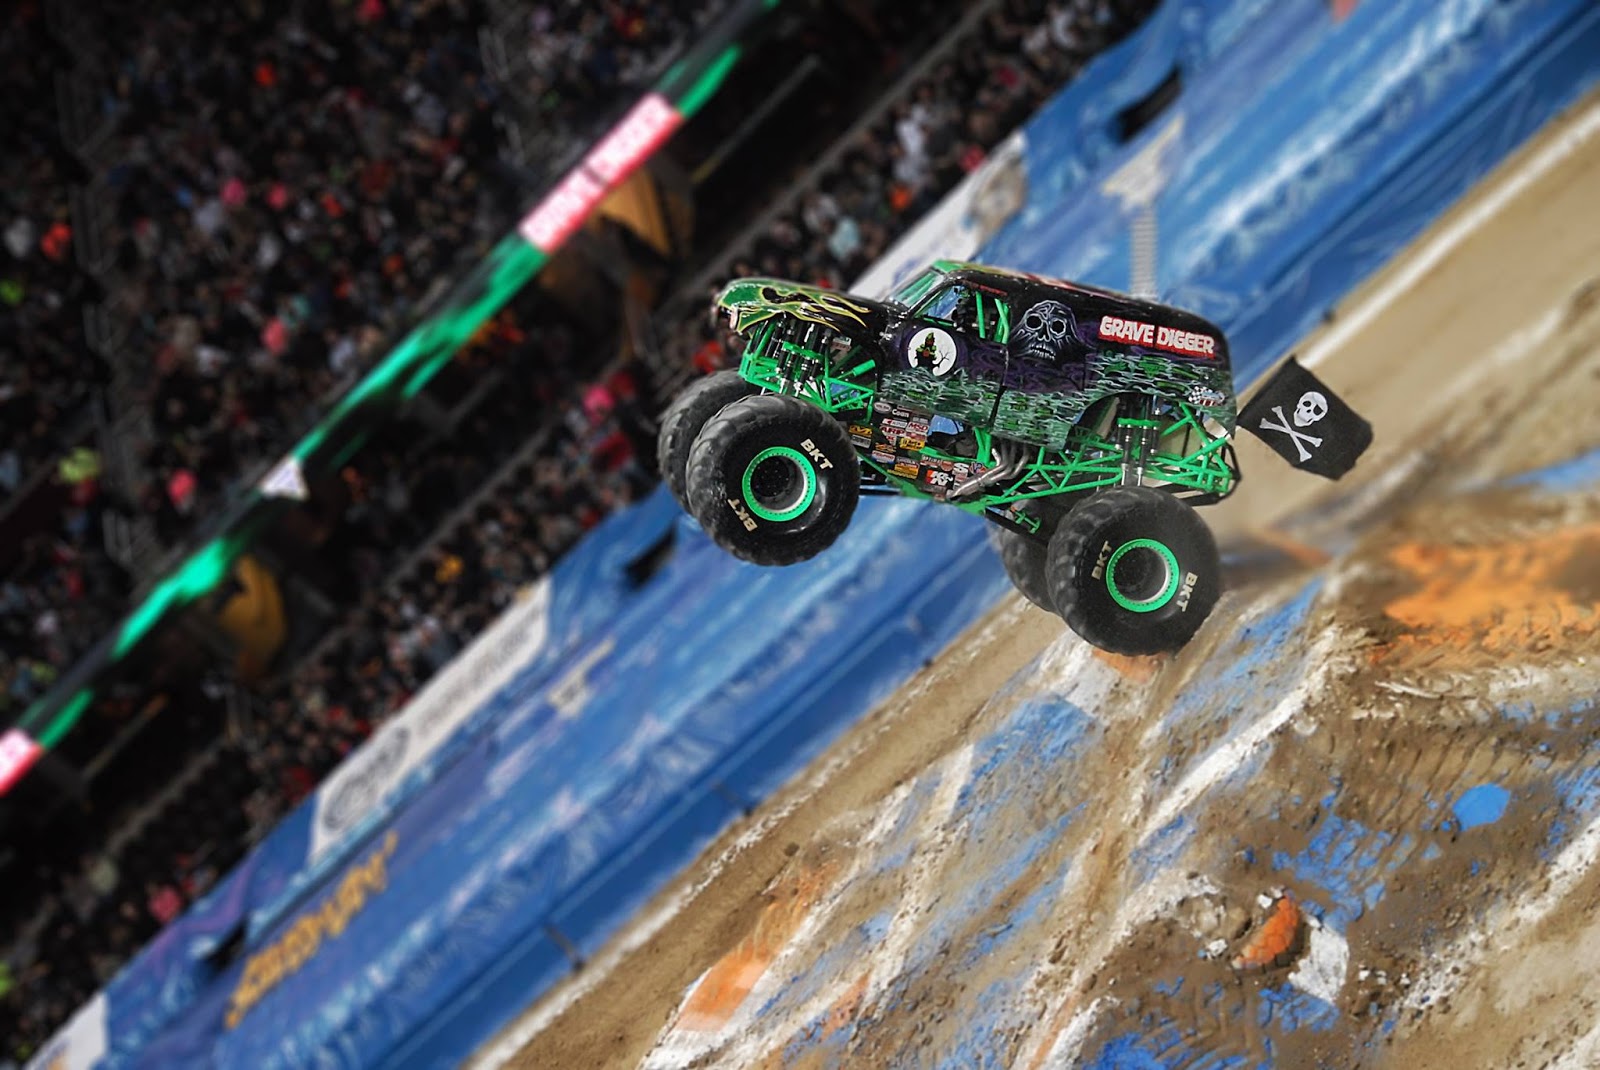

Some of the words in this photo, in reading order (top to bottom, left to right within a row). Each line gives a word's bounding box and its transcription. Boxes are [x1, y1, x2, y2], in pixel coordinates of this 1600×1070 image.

[1100, 315, 1155, 343] GRAVE
[1157, 326, 1215, 354] DIGGER
[908, 422, 929, 431] MSD
[800, 438, 833, 470] BKT
[727, 498, 758, 532] BKT
[1091, 540, 1112, 580] BKT
[1176, 572, 1198, 612] BKT
